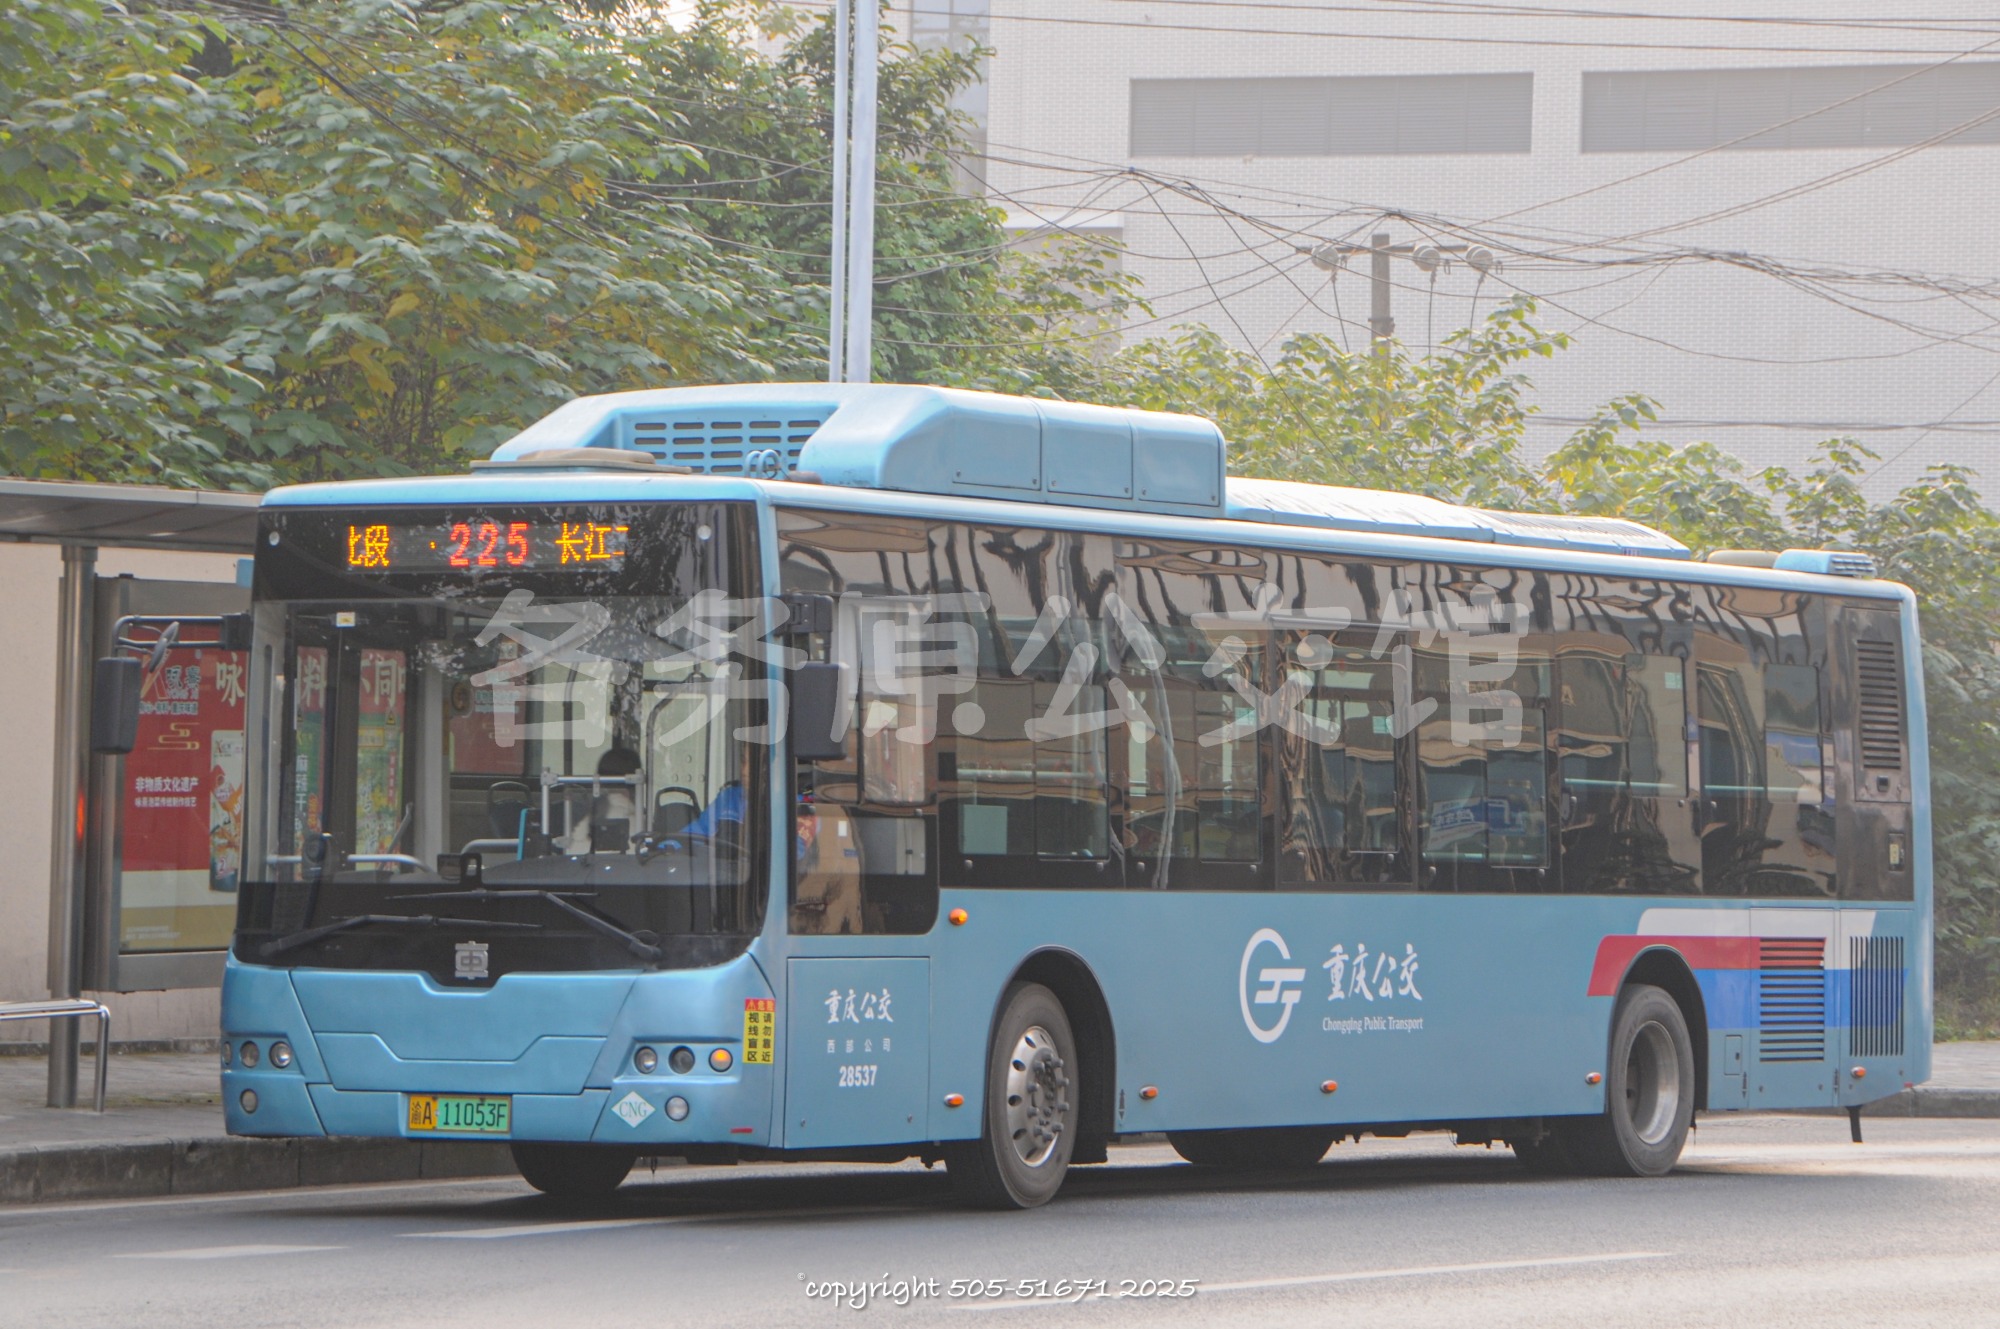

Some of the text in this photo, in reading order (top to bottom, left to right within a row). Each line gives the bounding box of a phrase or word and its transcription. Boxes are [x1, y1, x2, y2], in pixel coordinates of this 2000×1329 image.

[450, 522, 529, 566] 225
[135, 776, 199, 794] 非物质文化遗产
[1322, 943, 1423, 1002] 重庆公交
[824, 988, 894, 1024] 重庆公交
[747, 1013, 759, 1062] 视线盲区
[761, 1013, 772, 1062] 请勿靠近
[1322, 1017, 1423, 1034] Chongqing Public Transport
[827, 1037, 891, 1053] 西部公司
[839, 1065, 878, 1087] 28537
[619, 1101, 647, 1117] CNG
